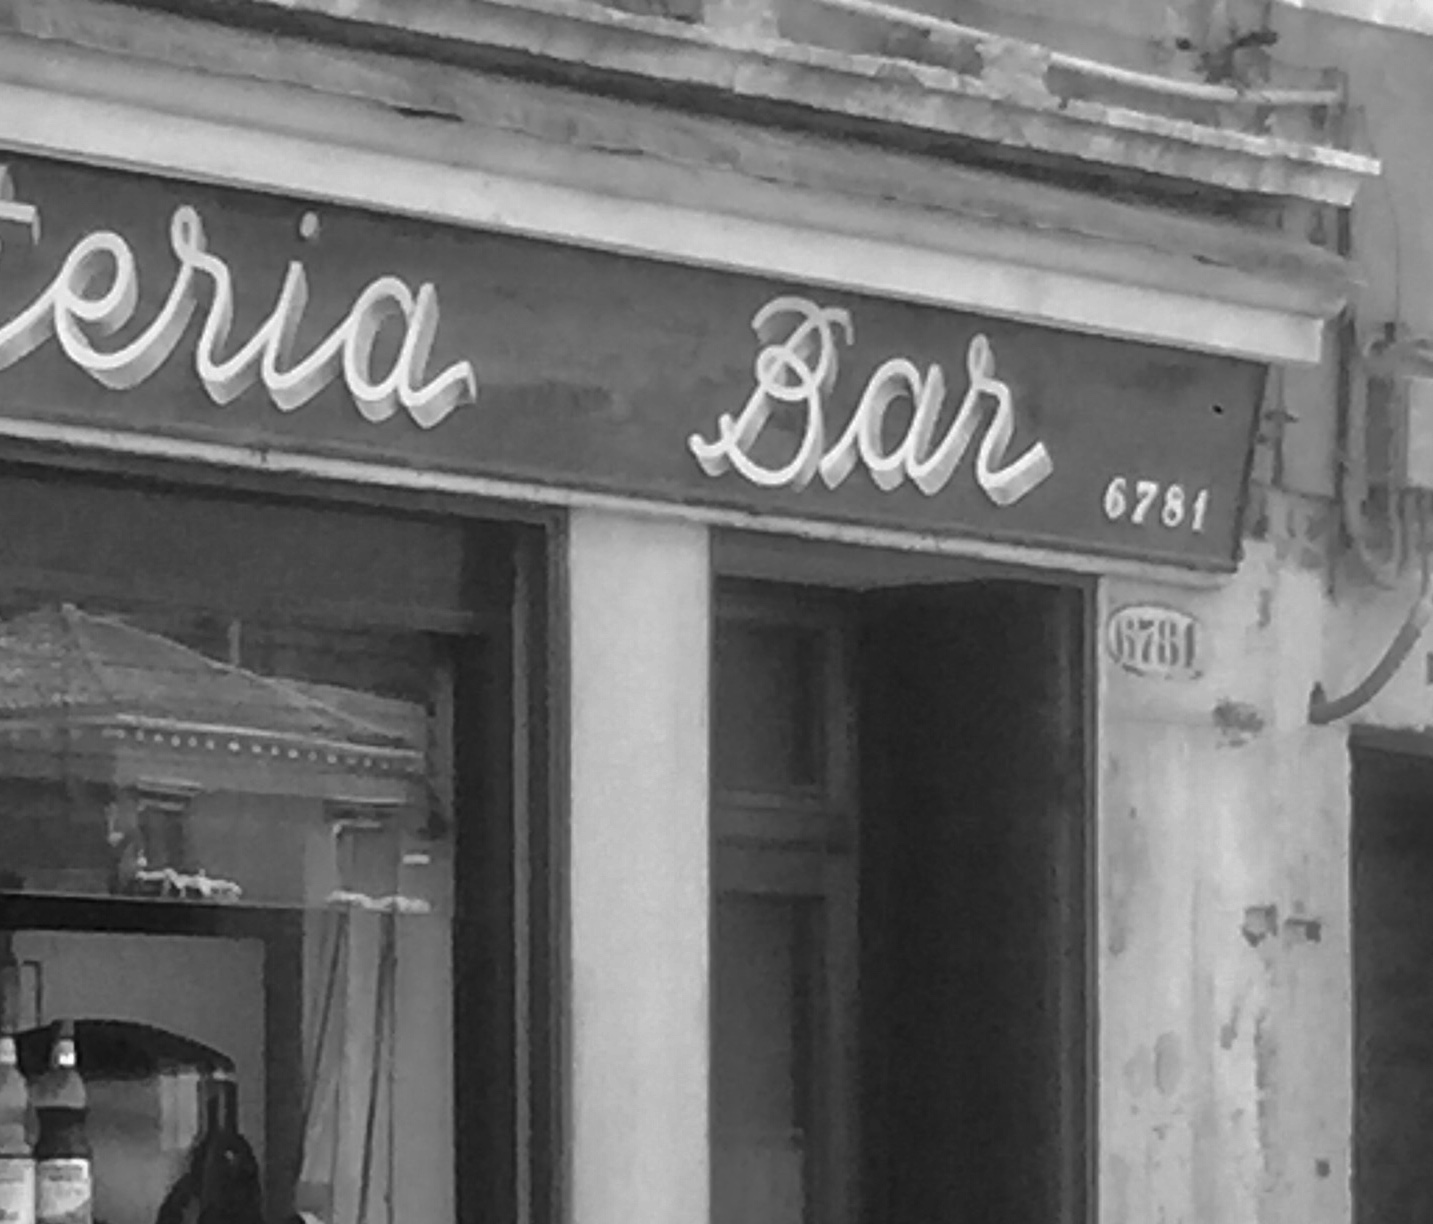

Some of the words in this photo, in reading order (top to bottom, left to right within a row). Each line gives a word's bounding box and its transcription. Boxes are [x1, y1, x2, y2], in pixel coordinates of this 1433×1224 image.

[687, 296, 1054, 506] Bar
[1103, 476, 1209, 532] 6781
[1113, 617, 1198, 668] 6781
